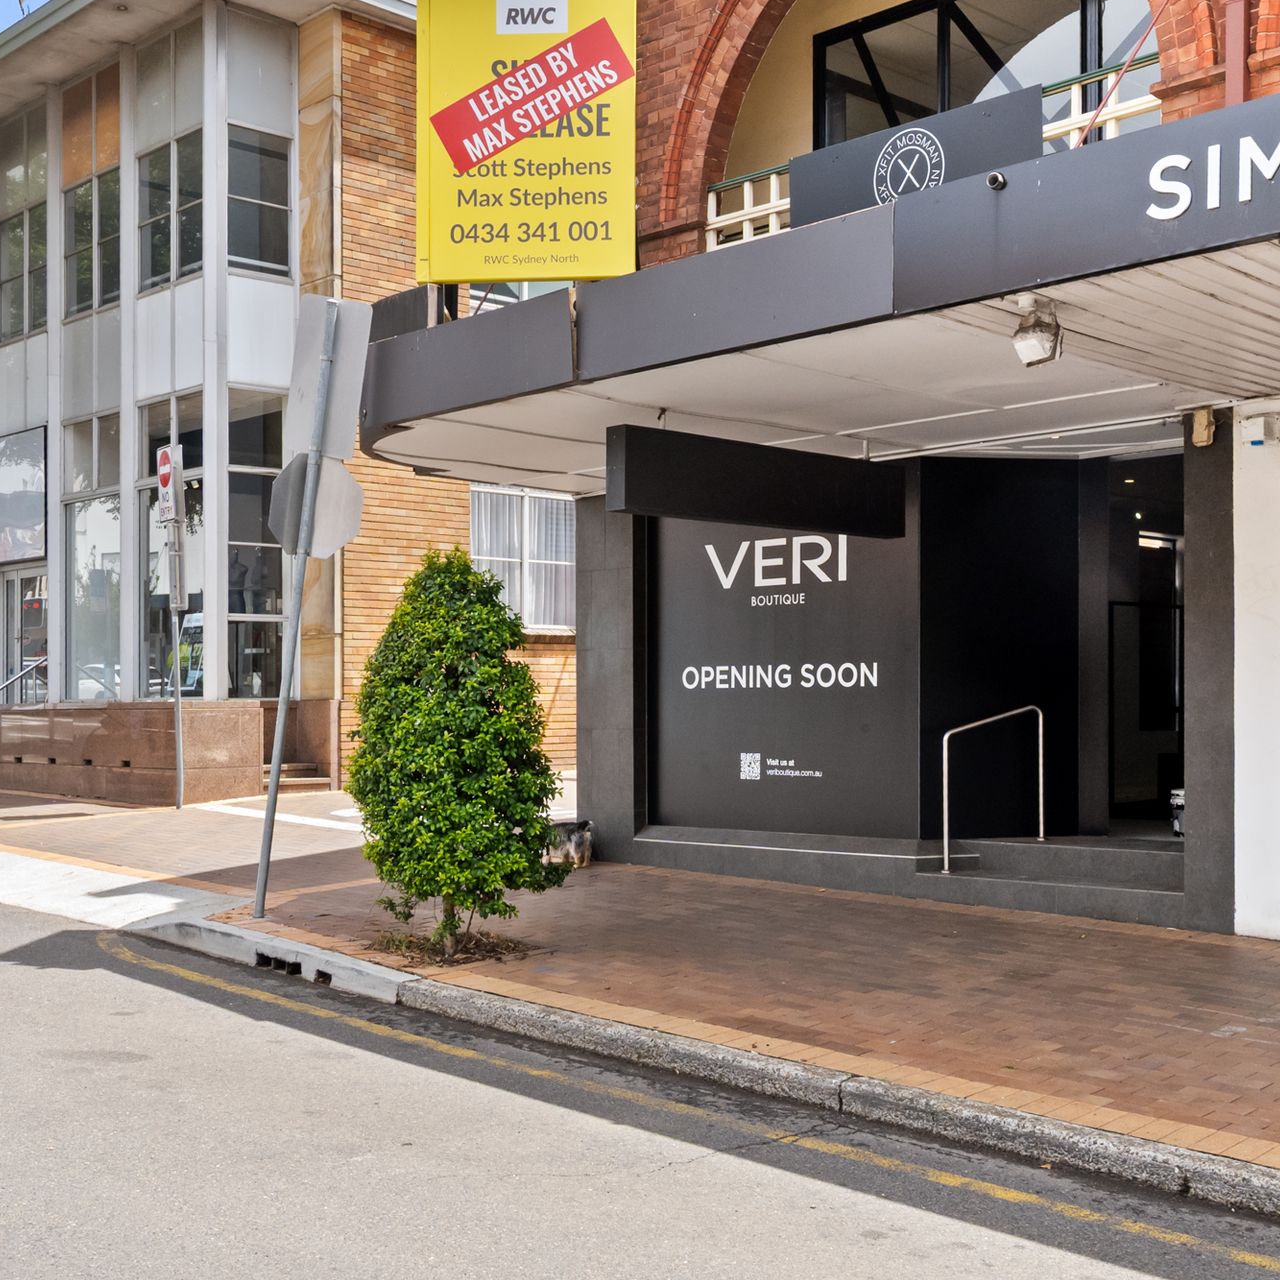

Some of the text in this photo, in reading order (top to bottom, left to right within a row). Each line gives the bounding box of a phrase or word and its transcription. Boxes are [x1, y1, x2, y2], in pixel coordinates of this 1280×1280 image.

[506, 6, 556, 25] RWC
[468, 63, 548, 122] LEASED
[545, 42, 580, 79] BY
[462, 59, 619, 163] MAX STEPHENS
[877, 133, 941, 176] XFIT MOSMAN
[513, 157, 612, 180] Stephens
[456, 186, 608, 210] Max Stephens
[449, 220, 613, 244] 0434 341 001
[483, 253, 580, 266] RWC Sydney North
[704, 533, 848, 590] VERI
[751, 592, 806, 607] BOUTIQUE
[681, 662, 879, 690] OPENING SOON
[766, 758, 779, 766] Visit
[766, 768, 822, 778] veriboutique.com.au
